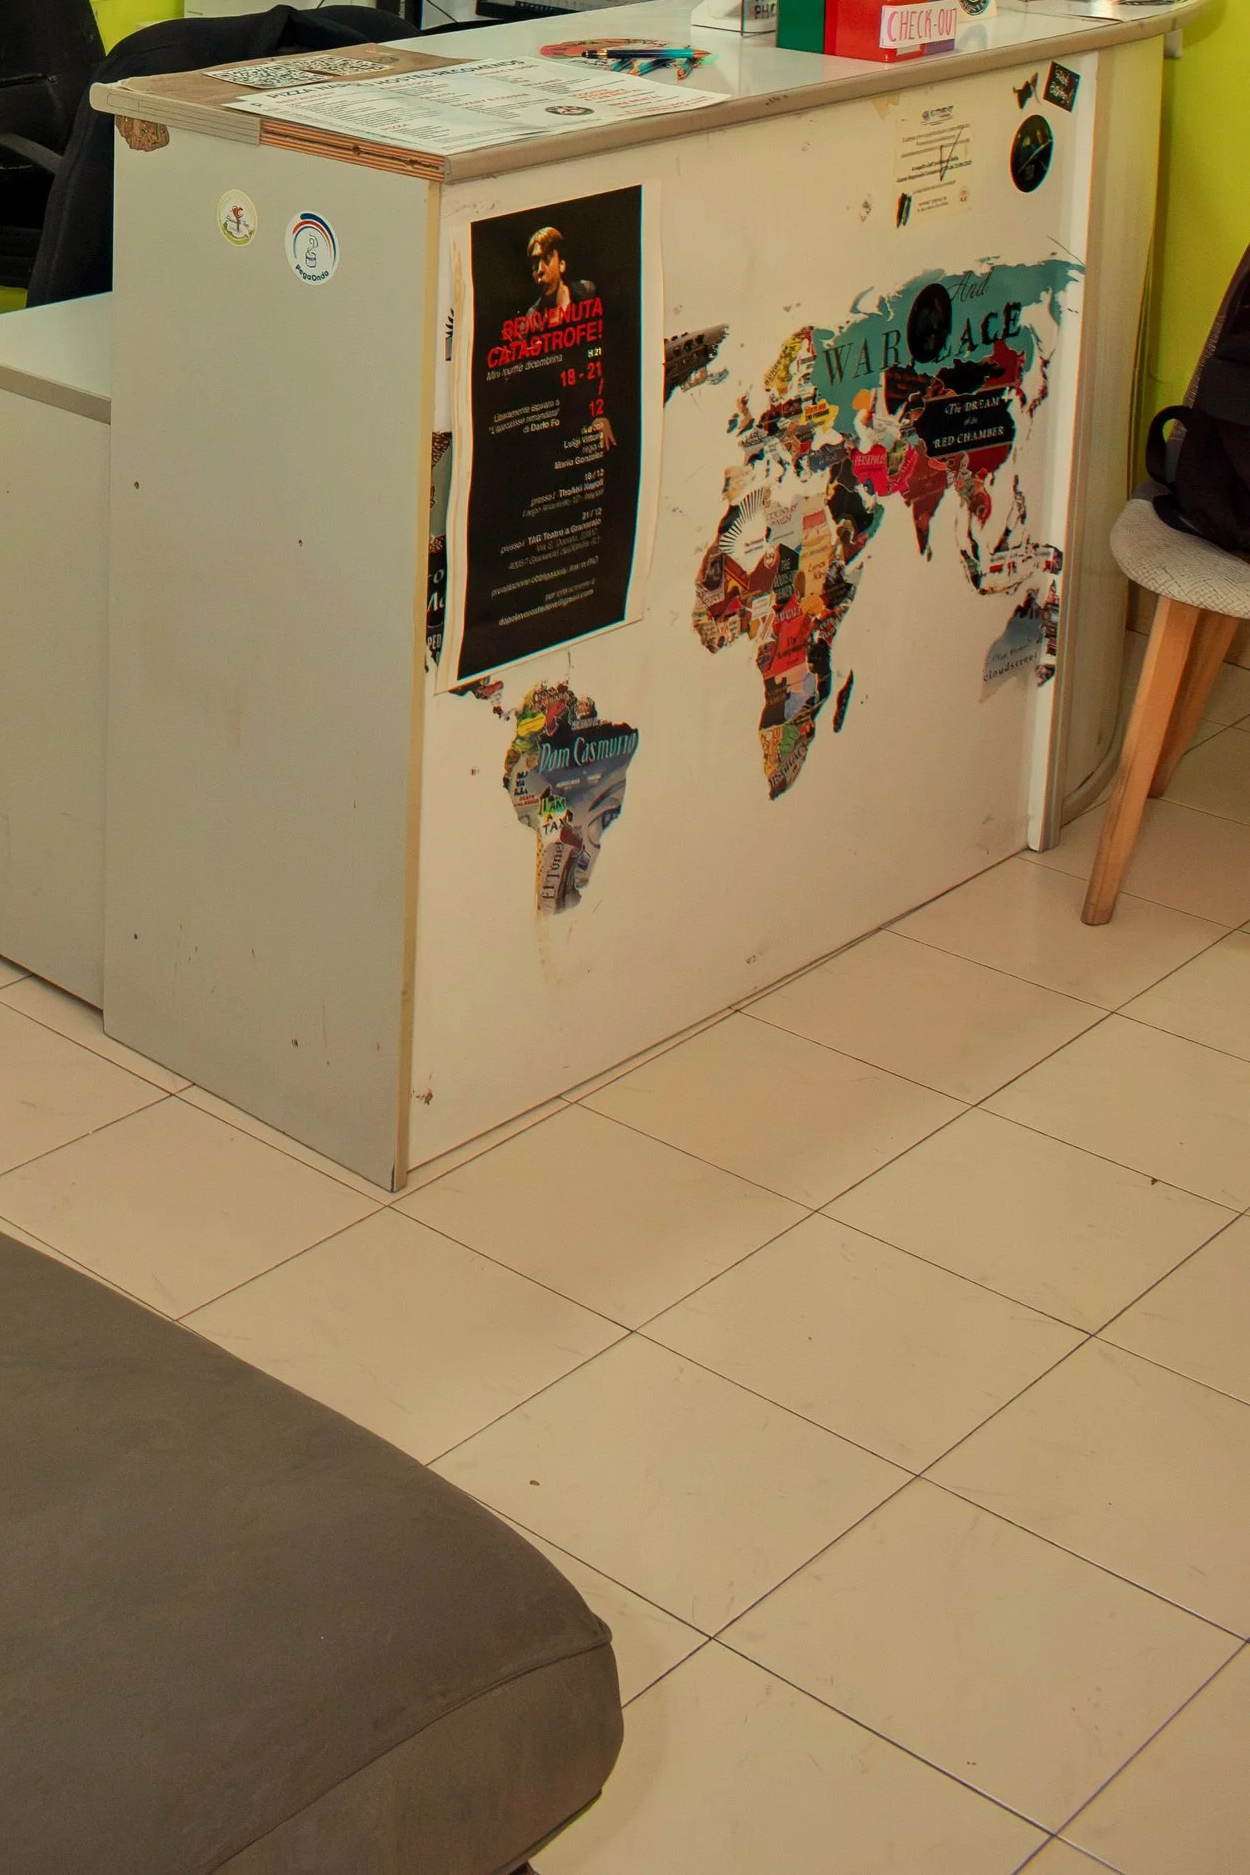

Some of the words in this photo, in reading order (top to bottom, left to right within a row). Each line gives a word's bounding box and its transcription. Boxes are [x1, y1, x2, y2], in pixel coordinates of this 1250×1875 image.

[502, 297, 604, 342] BENVENUTA
[823, 328, 903, 387] WAR
[949, 270, 992, 303] And
[487, 319, 604, 369] CATASTROFE!
[560, 368, 576, 387] 18
[587, 361, 602, 380] 21
[589, 398, 604, 417] 12
[965, 396, 1000, 412] DREAM
[933, 435, 955, 449] RED
[957, 426, 1005, 444] CHAMBER
[538, 743, 570, 774] Dom
[574, 732, 637, 766] Casmurro
